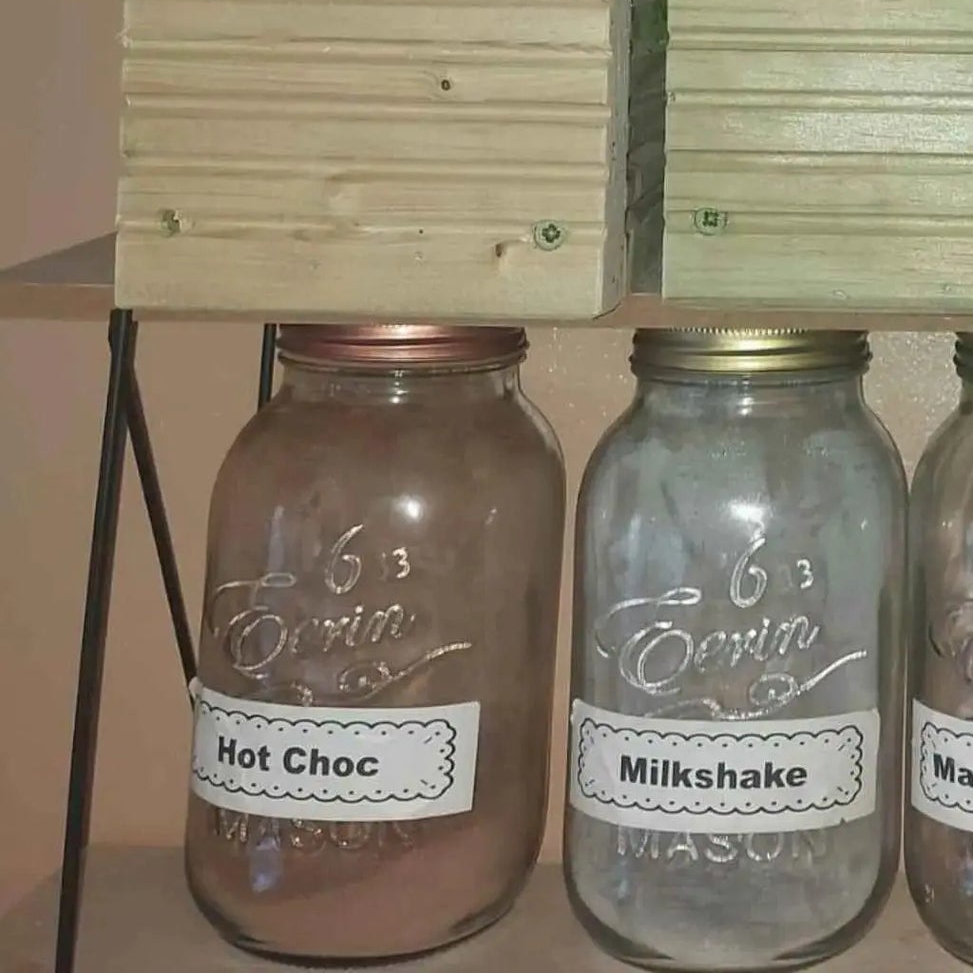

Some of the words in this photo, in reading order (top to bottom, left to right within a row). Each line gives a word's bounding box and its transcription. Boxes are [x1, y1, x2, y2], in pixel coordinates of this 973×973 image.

[325, 523, 364, 595] 6
[729, 536, 768, 609] 6
[217, 735, 271, 772] Hot
[282, 746, 380, 778] Choc
[619, 755, 809, 790] Milkshake
